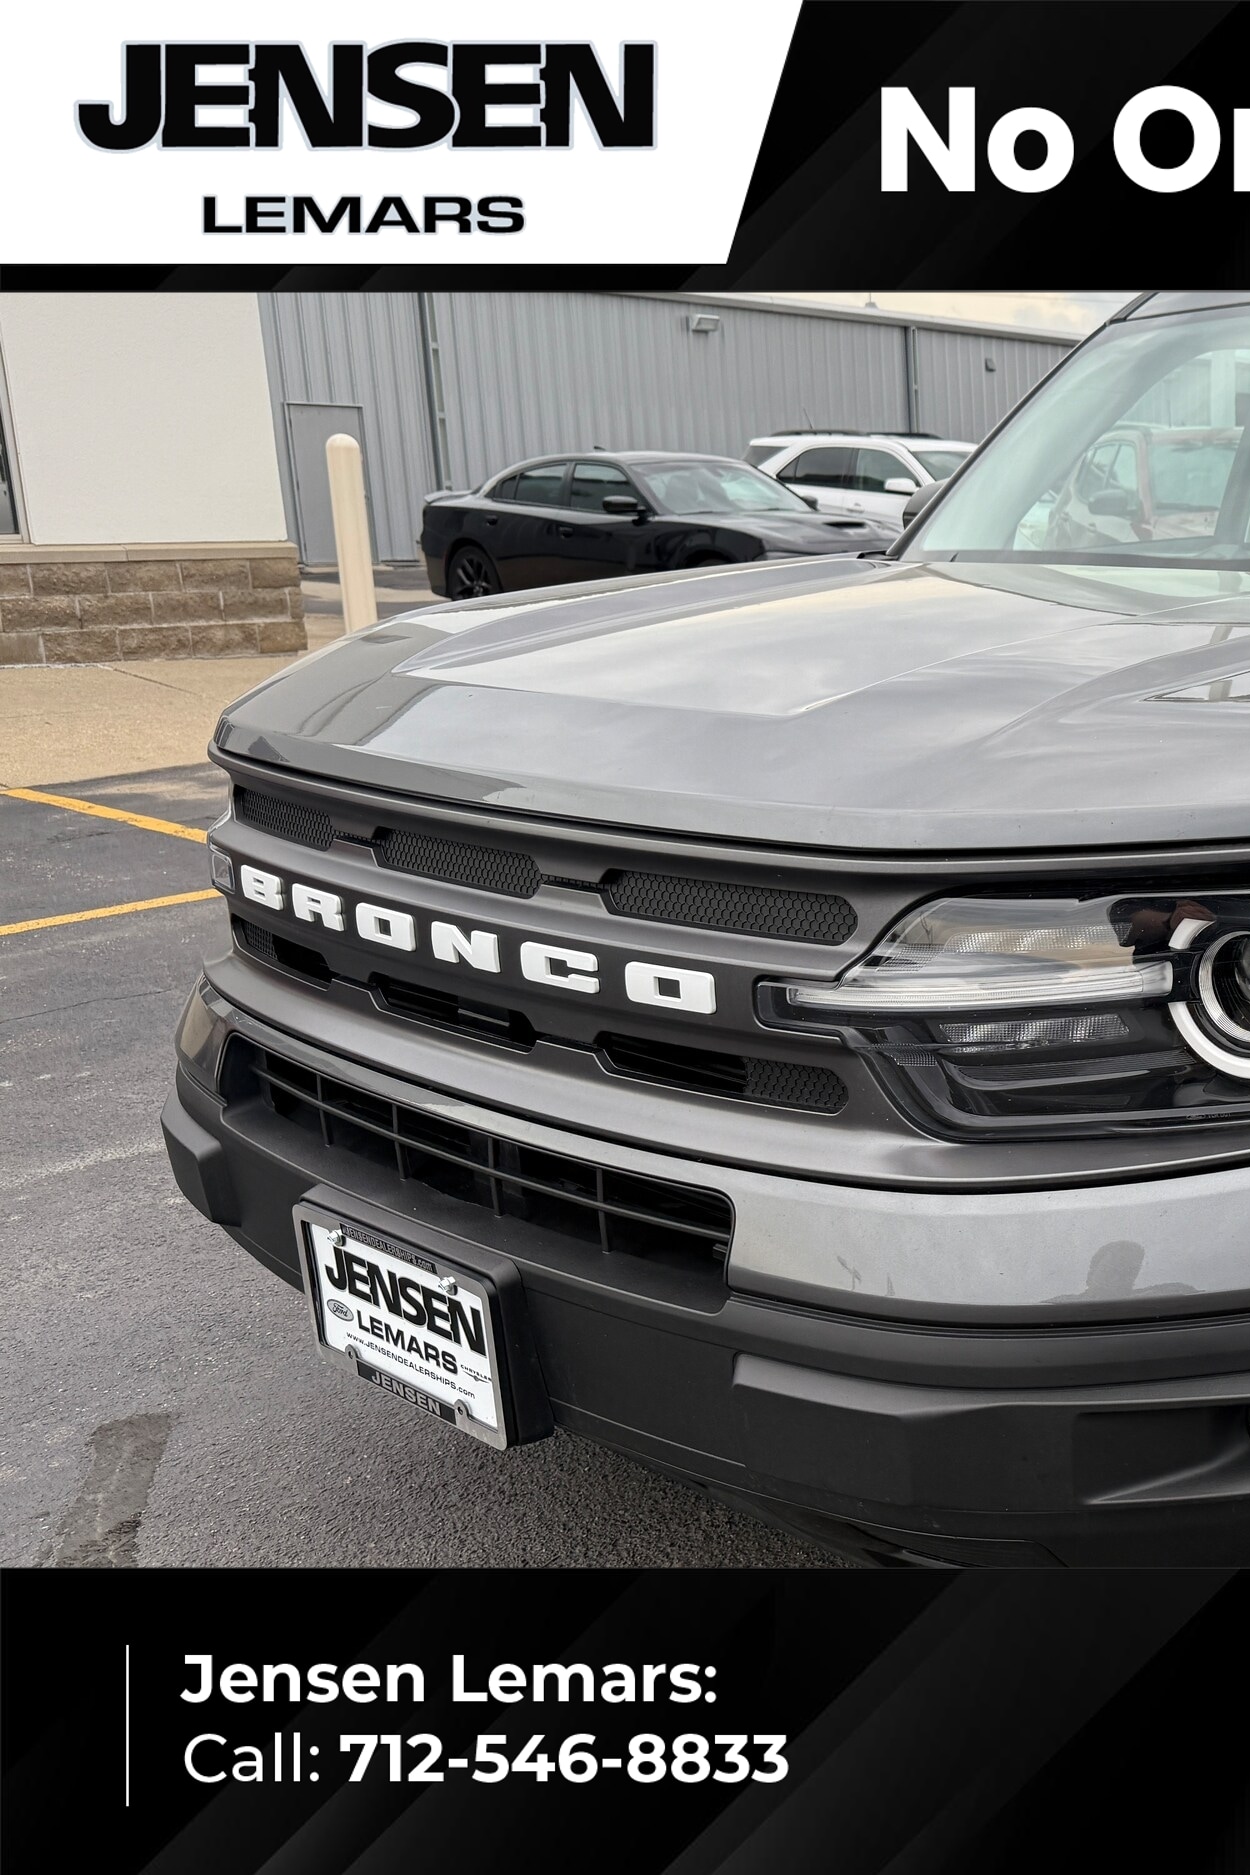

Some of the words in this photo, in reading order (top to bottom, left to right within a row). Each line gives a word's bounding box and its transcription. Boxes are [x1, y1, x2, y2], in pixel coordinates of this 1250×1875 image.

[240, 864, 716, 1014] BRONCO
[324, 1246, 487, 1358] JENSEN
[330, 1301, 350, 1319] Ford
[346, 1332, 476, 1399] www.JENSENDEALERSHIPS.com
[357, 1309, 459, 1376] LEMARS
[371, 1370, 442, 1417] JENSEN
